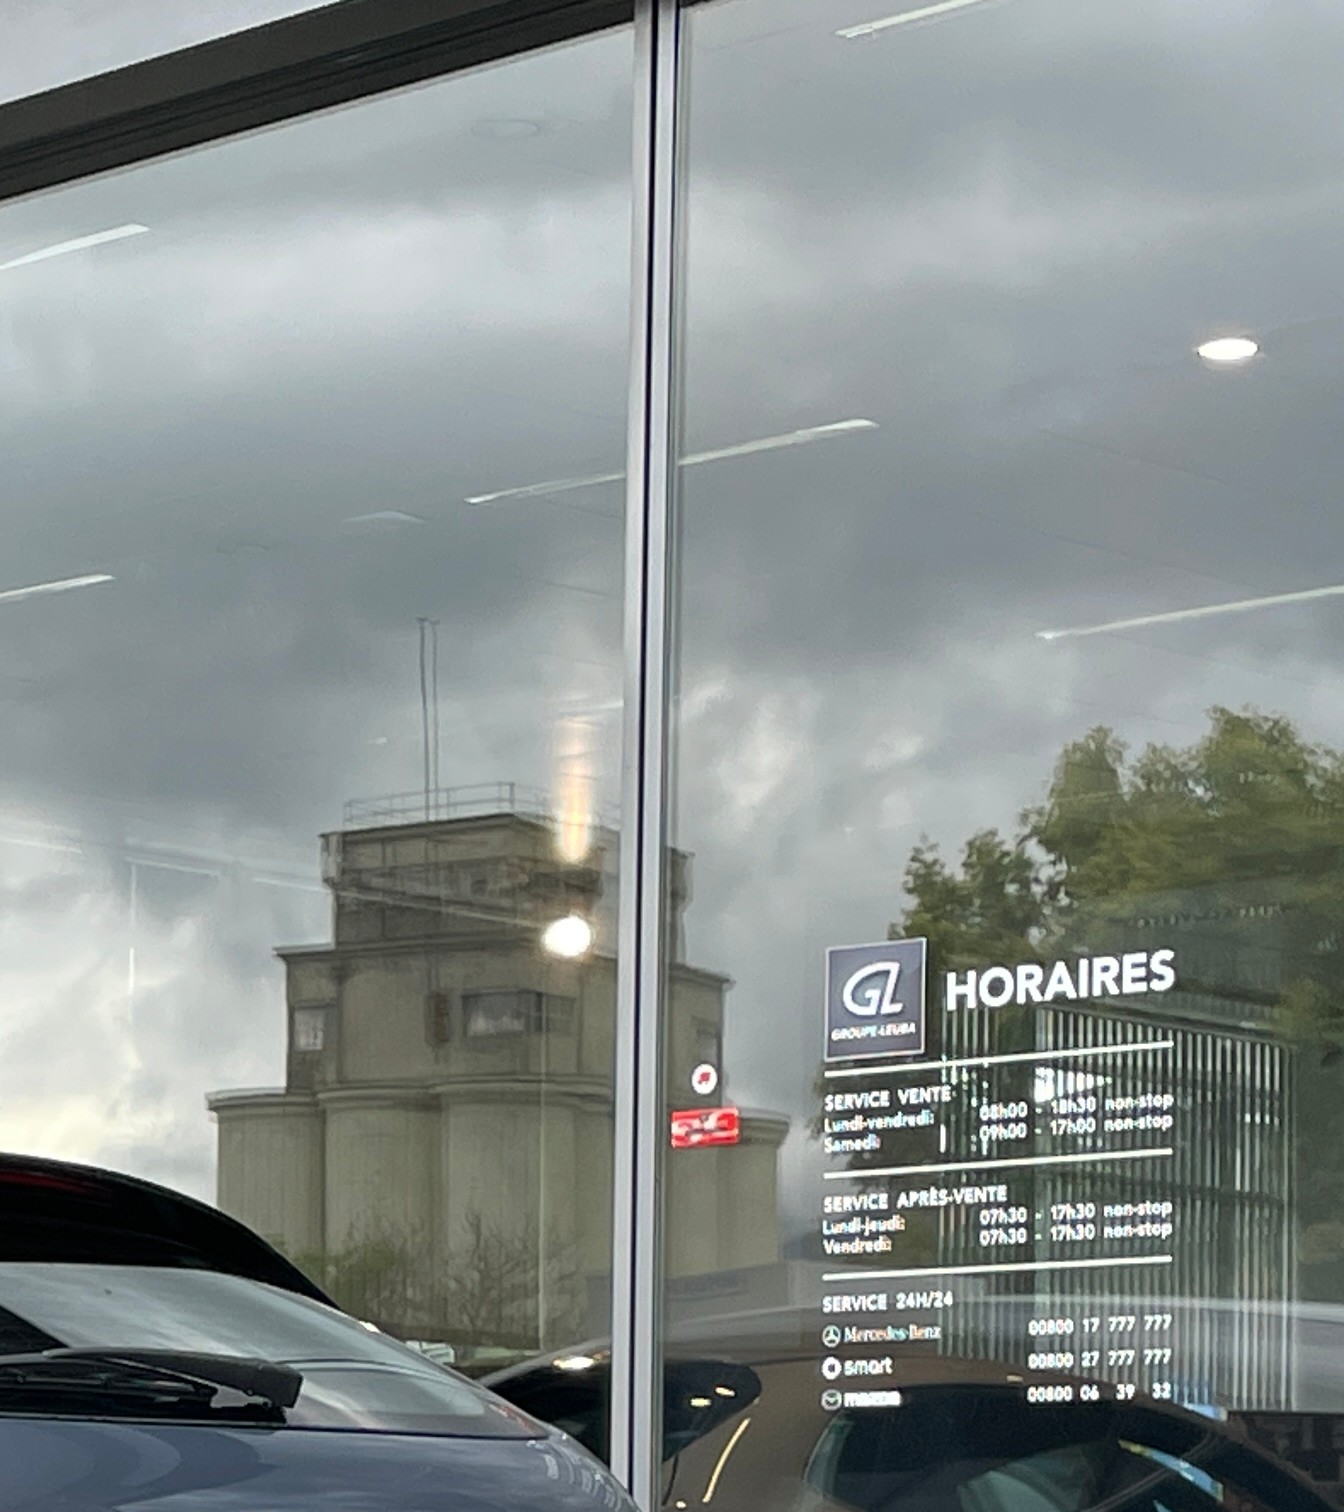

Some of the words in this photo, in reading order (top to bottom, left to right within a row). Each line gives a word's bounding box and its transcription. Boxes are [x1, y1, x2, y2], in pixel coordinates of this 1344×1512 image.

[843, 962, 904, 1016] GL
[946, 950, 1176, 1011] HORAIRES
[824, 1090, 890, 1112] SERVICE
[898, 1085, 952, 1105] VENTE
[1105, 1093, 1174, 1111] non-stop
[979, 1122, 1028, 1142] 09h00
[1050, 1117, 1096, 1135] 17h00
[1104, 1114, 1173, 1132] non-stop
[823, 1193, 889, 1213] SERVICE
[896, 1185, 1008, 1209] APRÈS-VENTE
[979, 1206, 1028, 1226] 07h30
[1050, 1202, 1096, 1220] 17h30
[1103, 1200, 1173, 1218] non-stop
[979, 1227, 1028, 1246] 07h30
[1050, 1223, 1096, 1242] 17h30
[1103, 1221, 1173, 1240] non-stop
[822, 1293, 888, 1313] SERVICE
[896, 1290, 953, 1310] 24H/24
[1082, 1316, 1100, 1334] 17
[1108, 1314, 1136, 1332] 777
[1144, 1313, 1172, 1331] 777
[843, 1356, 894, 1377] smart
[1081, 1350, 1100, 1368] 27
[1108, 1349, 1136, 1366] 777
[1144, 1348, 1172, 1365] 777
[1079, 1383, 1100, 1401] 06
